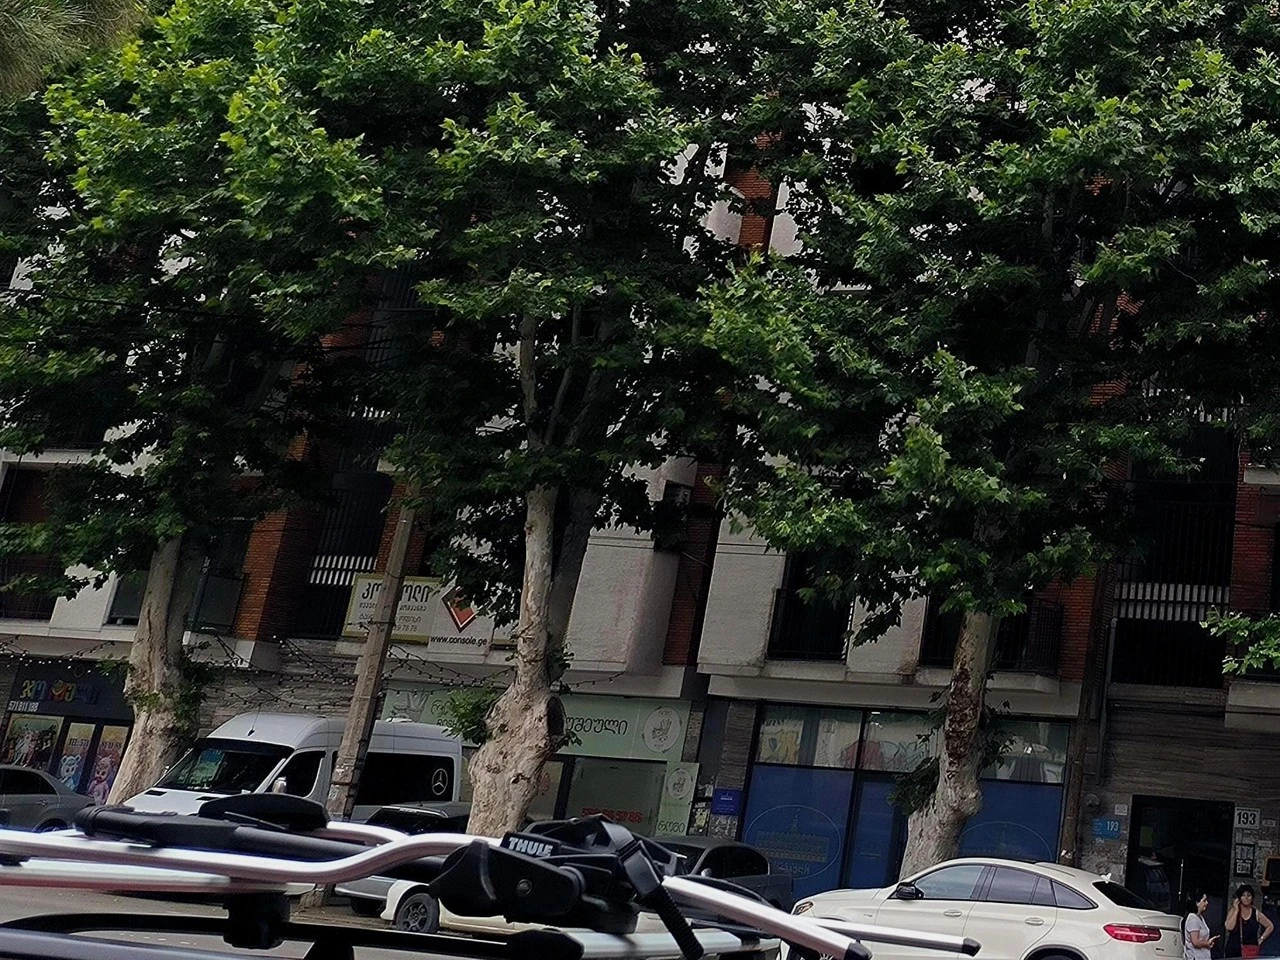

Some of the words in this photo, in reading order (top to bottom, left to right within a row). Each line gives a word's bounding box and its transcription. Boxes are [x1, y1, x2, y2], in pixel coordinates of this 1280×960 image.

[362, 583, 431, 602] კოოლი
[430, 636, 487, 647] www.console.ge
[1106, 820, 1119, 832] 193
[1237, 811, 1256, 826] 193
[508, 836, 554, 858] THULE
